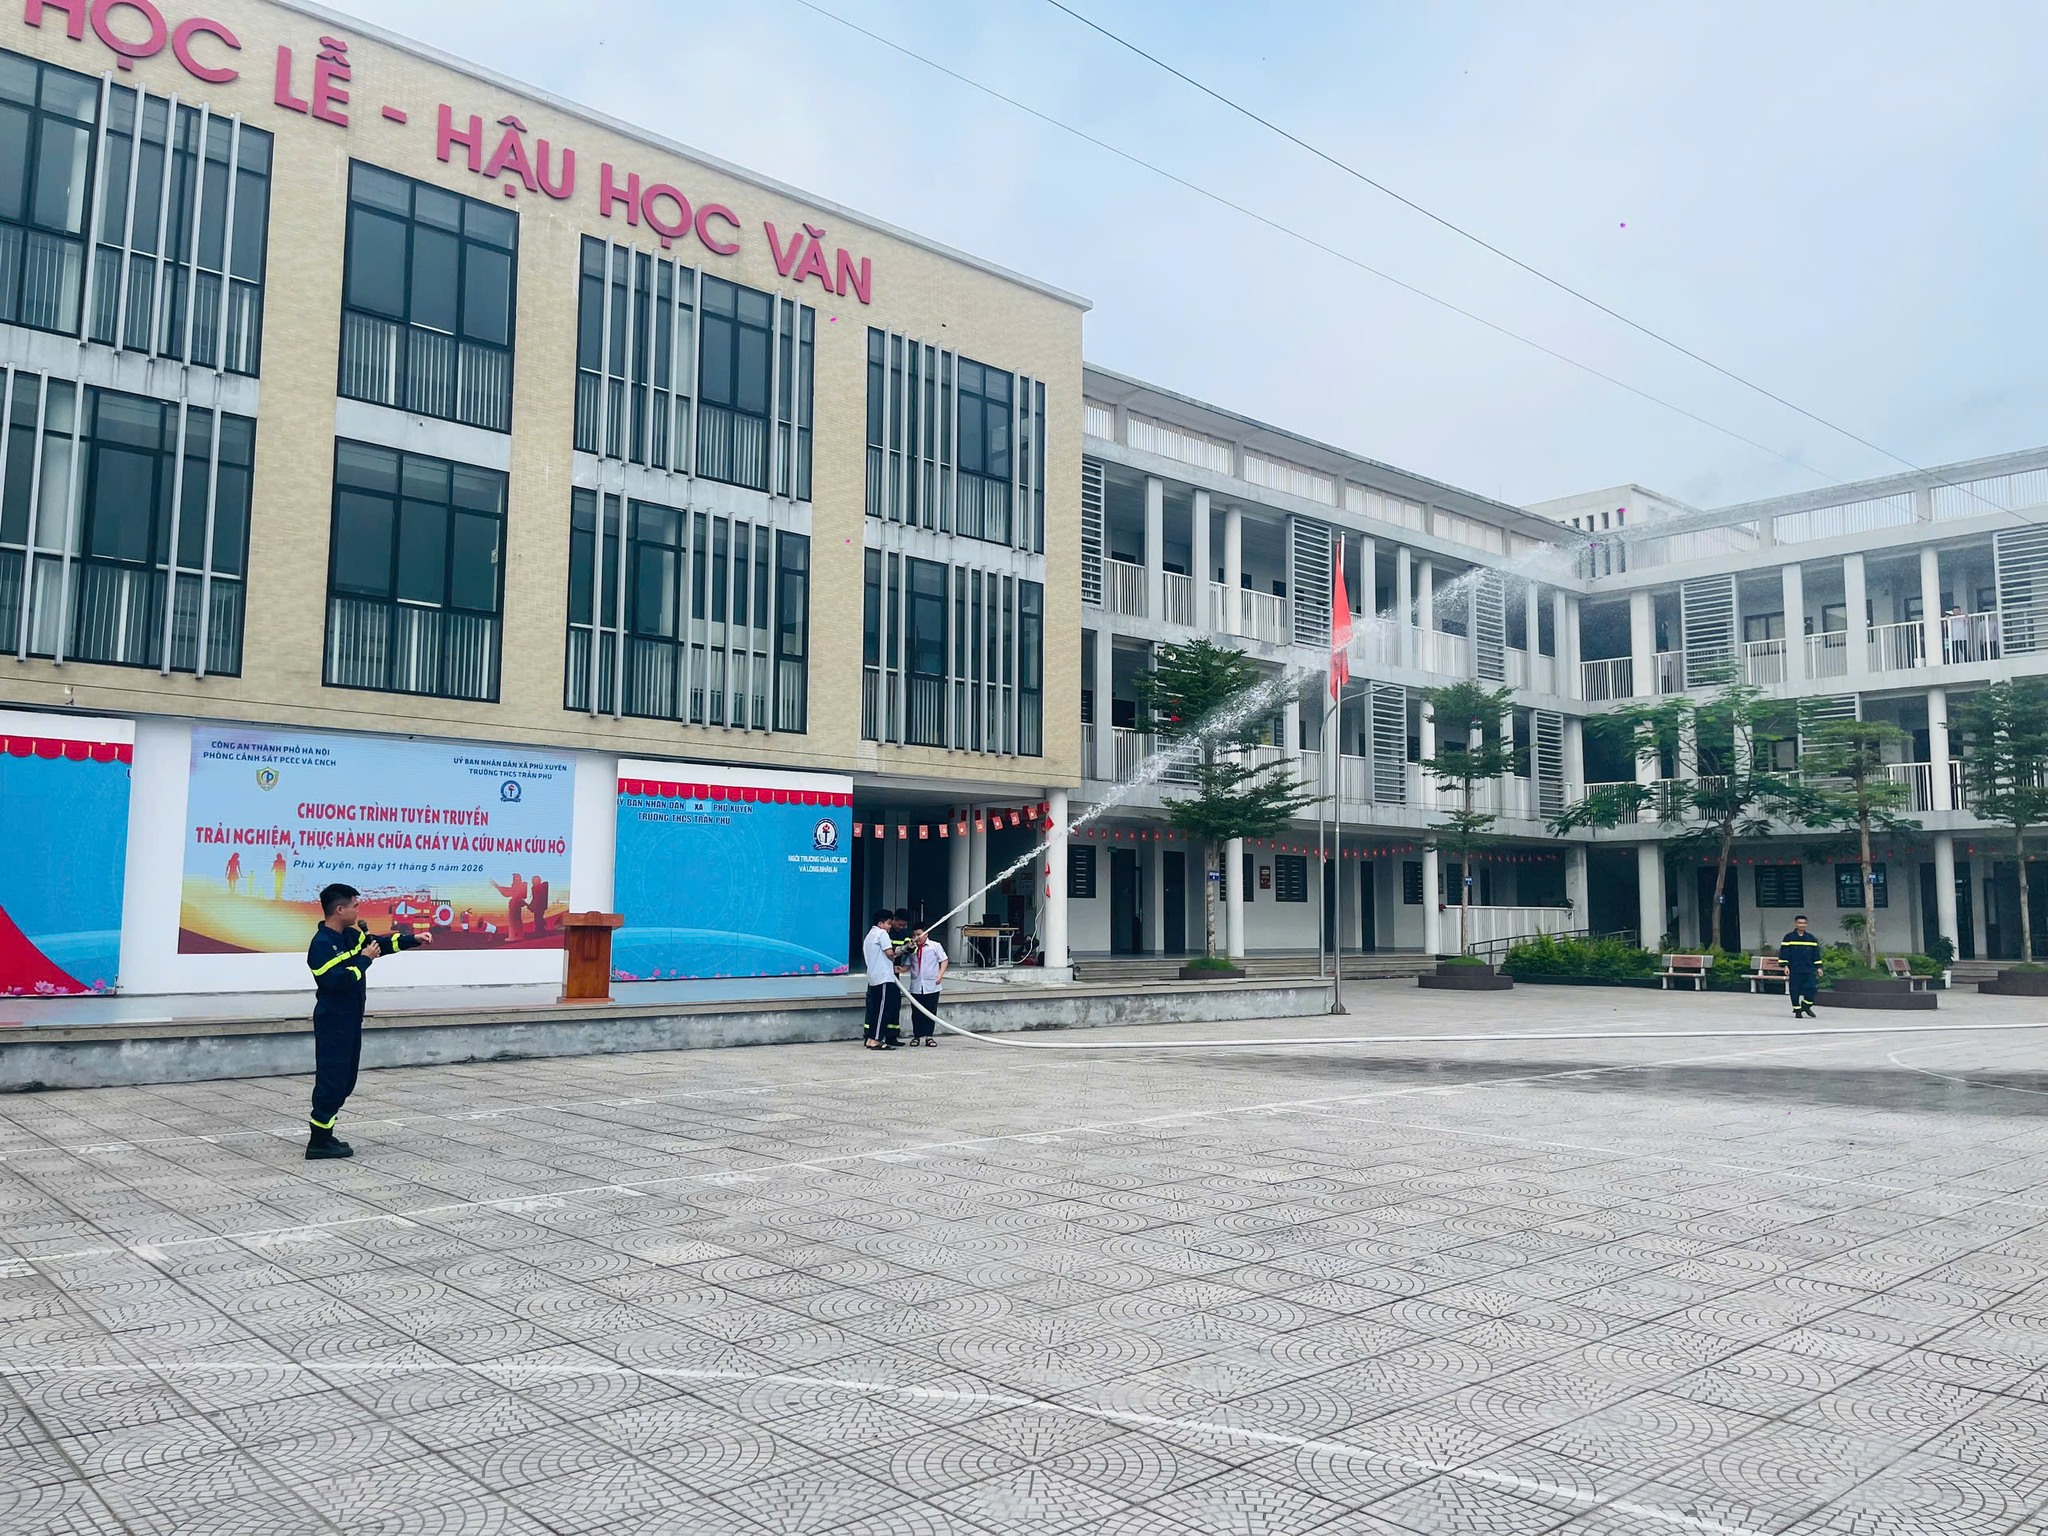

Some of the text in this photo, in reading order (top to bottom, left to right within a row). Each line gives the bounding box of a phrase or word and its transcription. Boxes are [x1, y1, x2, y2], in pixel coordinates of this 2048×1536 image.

[275, 36, 351, 127] LỄ
[381, 104, 408, 123] -
[436, 105, 576, 200] HẬU
[600, 163, 741, 256] HỌC
[763, 221, 873, 305] VĂN
[211, 740, 235, 749] CÔNG
[251, 744, 281, 752] THÀNH
[203, 751, 234, 760] PHÒNG
[262, 754, 278, 763] SÁT
[280, 756, 300, 764] PCCC
[314, 758, 336, 766] CNCH
[464, 758, 480, 766] BAN
[481, 759, 501, 767] NHÂN
[499, 770, 517, 778] THCS
[627, 798, 643, 807] BAN
[297, 802, 489, 826] CHƯƠNG TRÌNH TUYÊN TRUYỀN
[672, 814, 692, 823] THCS
[195, 822, 230, 844] TRẢI
[233, 825, 296, 850] NGHIỆM,
[335, 828, 375, 848] HÀNH
[377, 830, 413, 850] CHỮA
[415, 831, 450, 851] CHÁY
[452, 832, 469, 851] VÀ
[471, 834, 494, 852] CỨU
[496, 837, 522, 856] NẠN
[524, 835, 546, 854] CỨU
[548, 836, 566, 857] HỘ
[293, 859, 315, 869] Phú
[357, 861, 383, 872] ngày
[386, 862, 397, 871] 11
[399, 863, 428, 873] tháng
[430, 863, 437, 872] 5
[438, 864, 459, 872] năm
[461, 864, 484, 872] 2026
